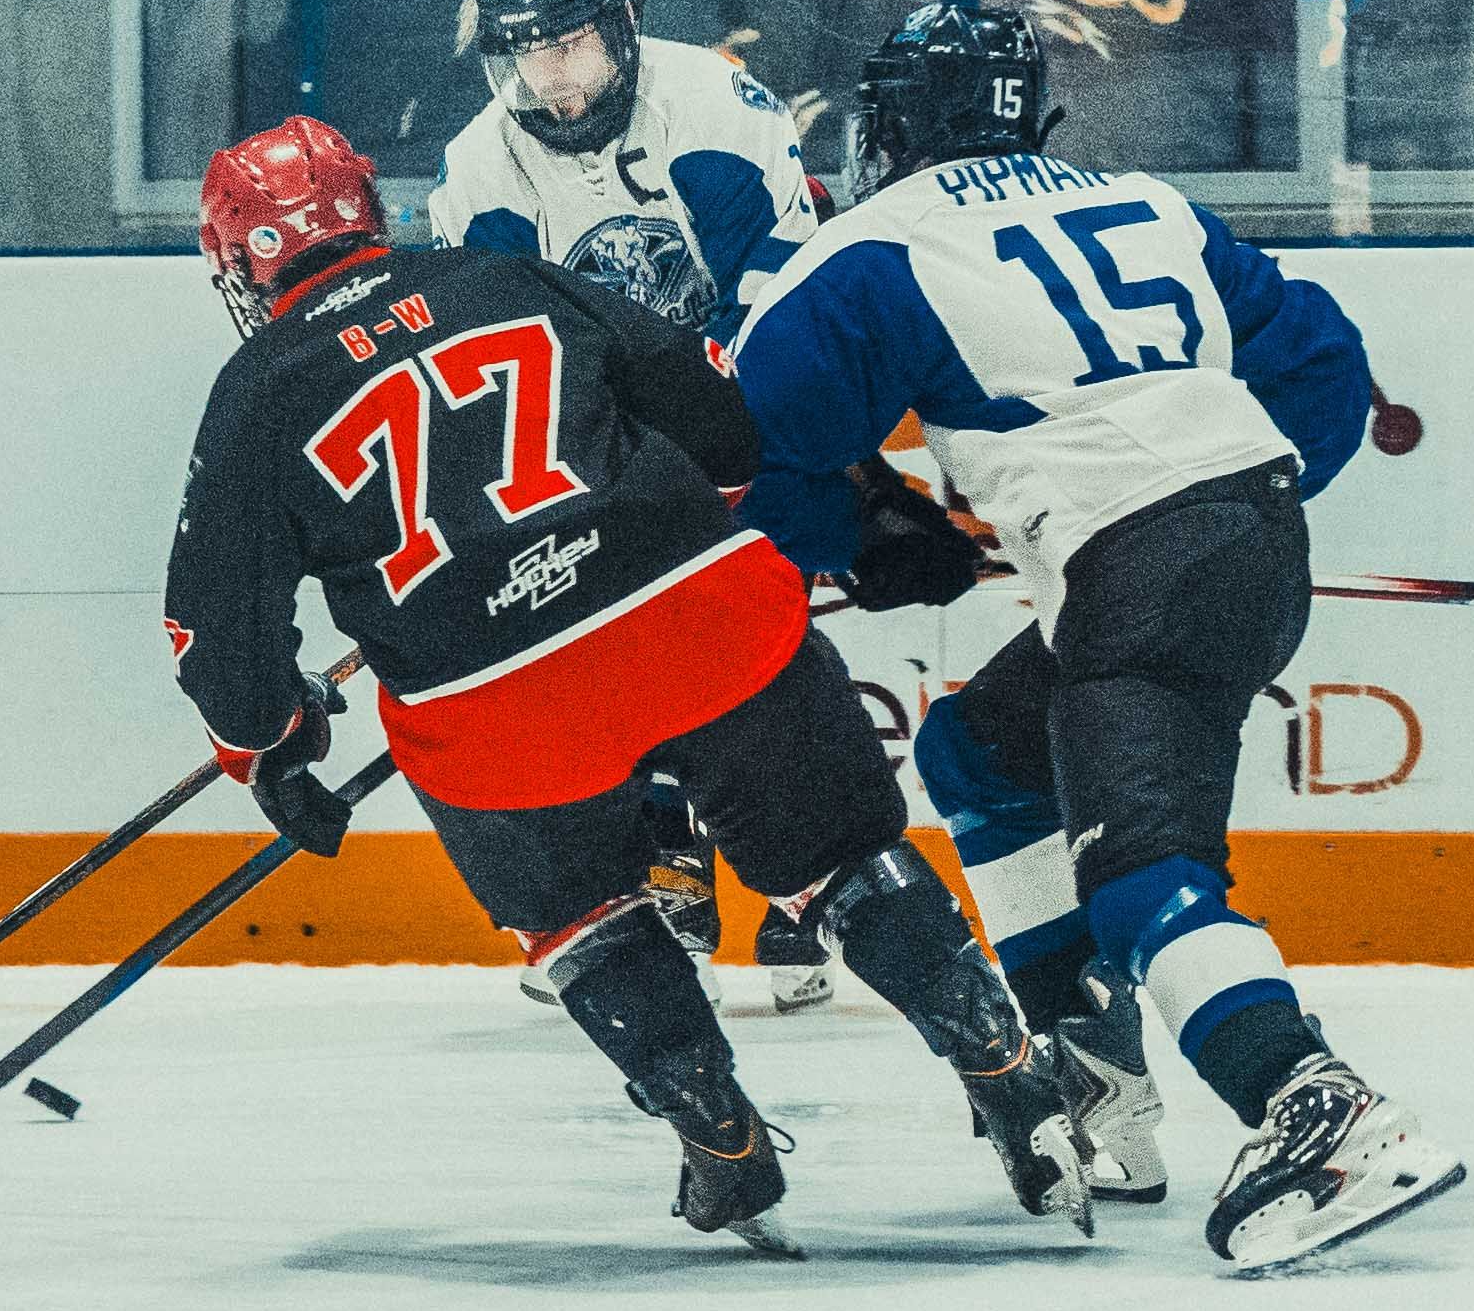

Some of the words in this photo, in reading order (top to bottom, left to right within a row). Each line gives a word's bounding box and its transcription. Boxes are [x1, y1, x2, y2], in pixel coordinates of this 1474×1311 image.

[992, 77, 1023, 120] 15
[615, 147, 669, 206] C
[993, 200, 1205, 387] 15
[303, 314, 591, 607] 77
